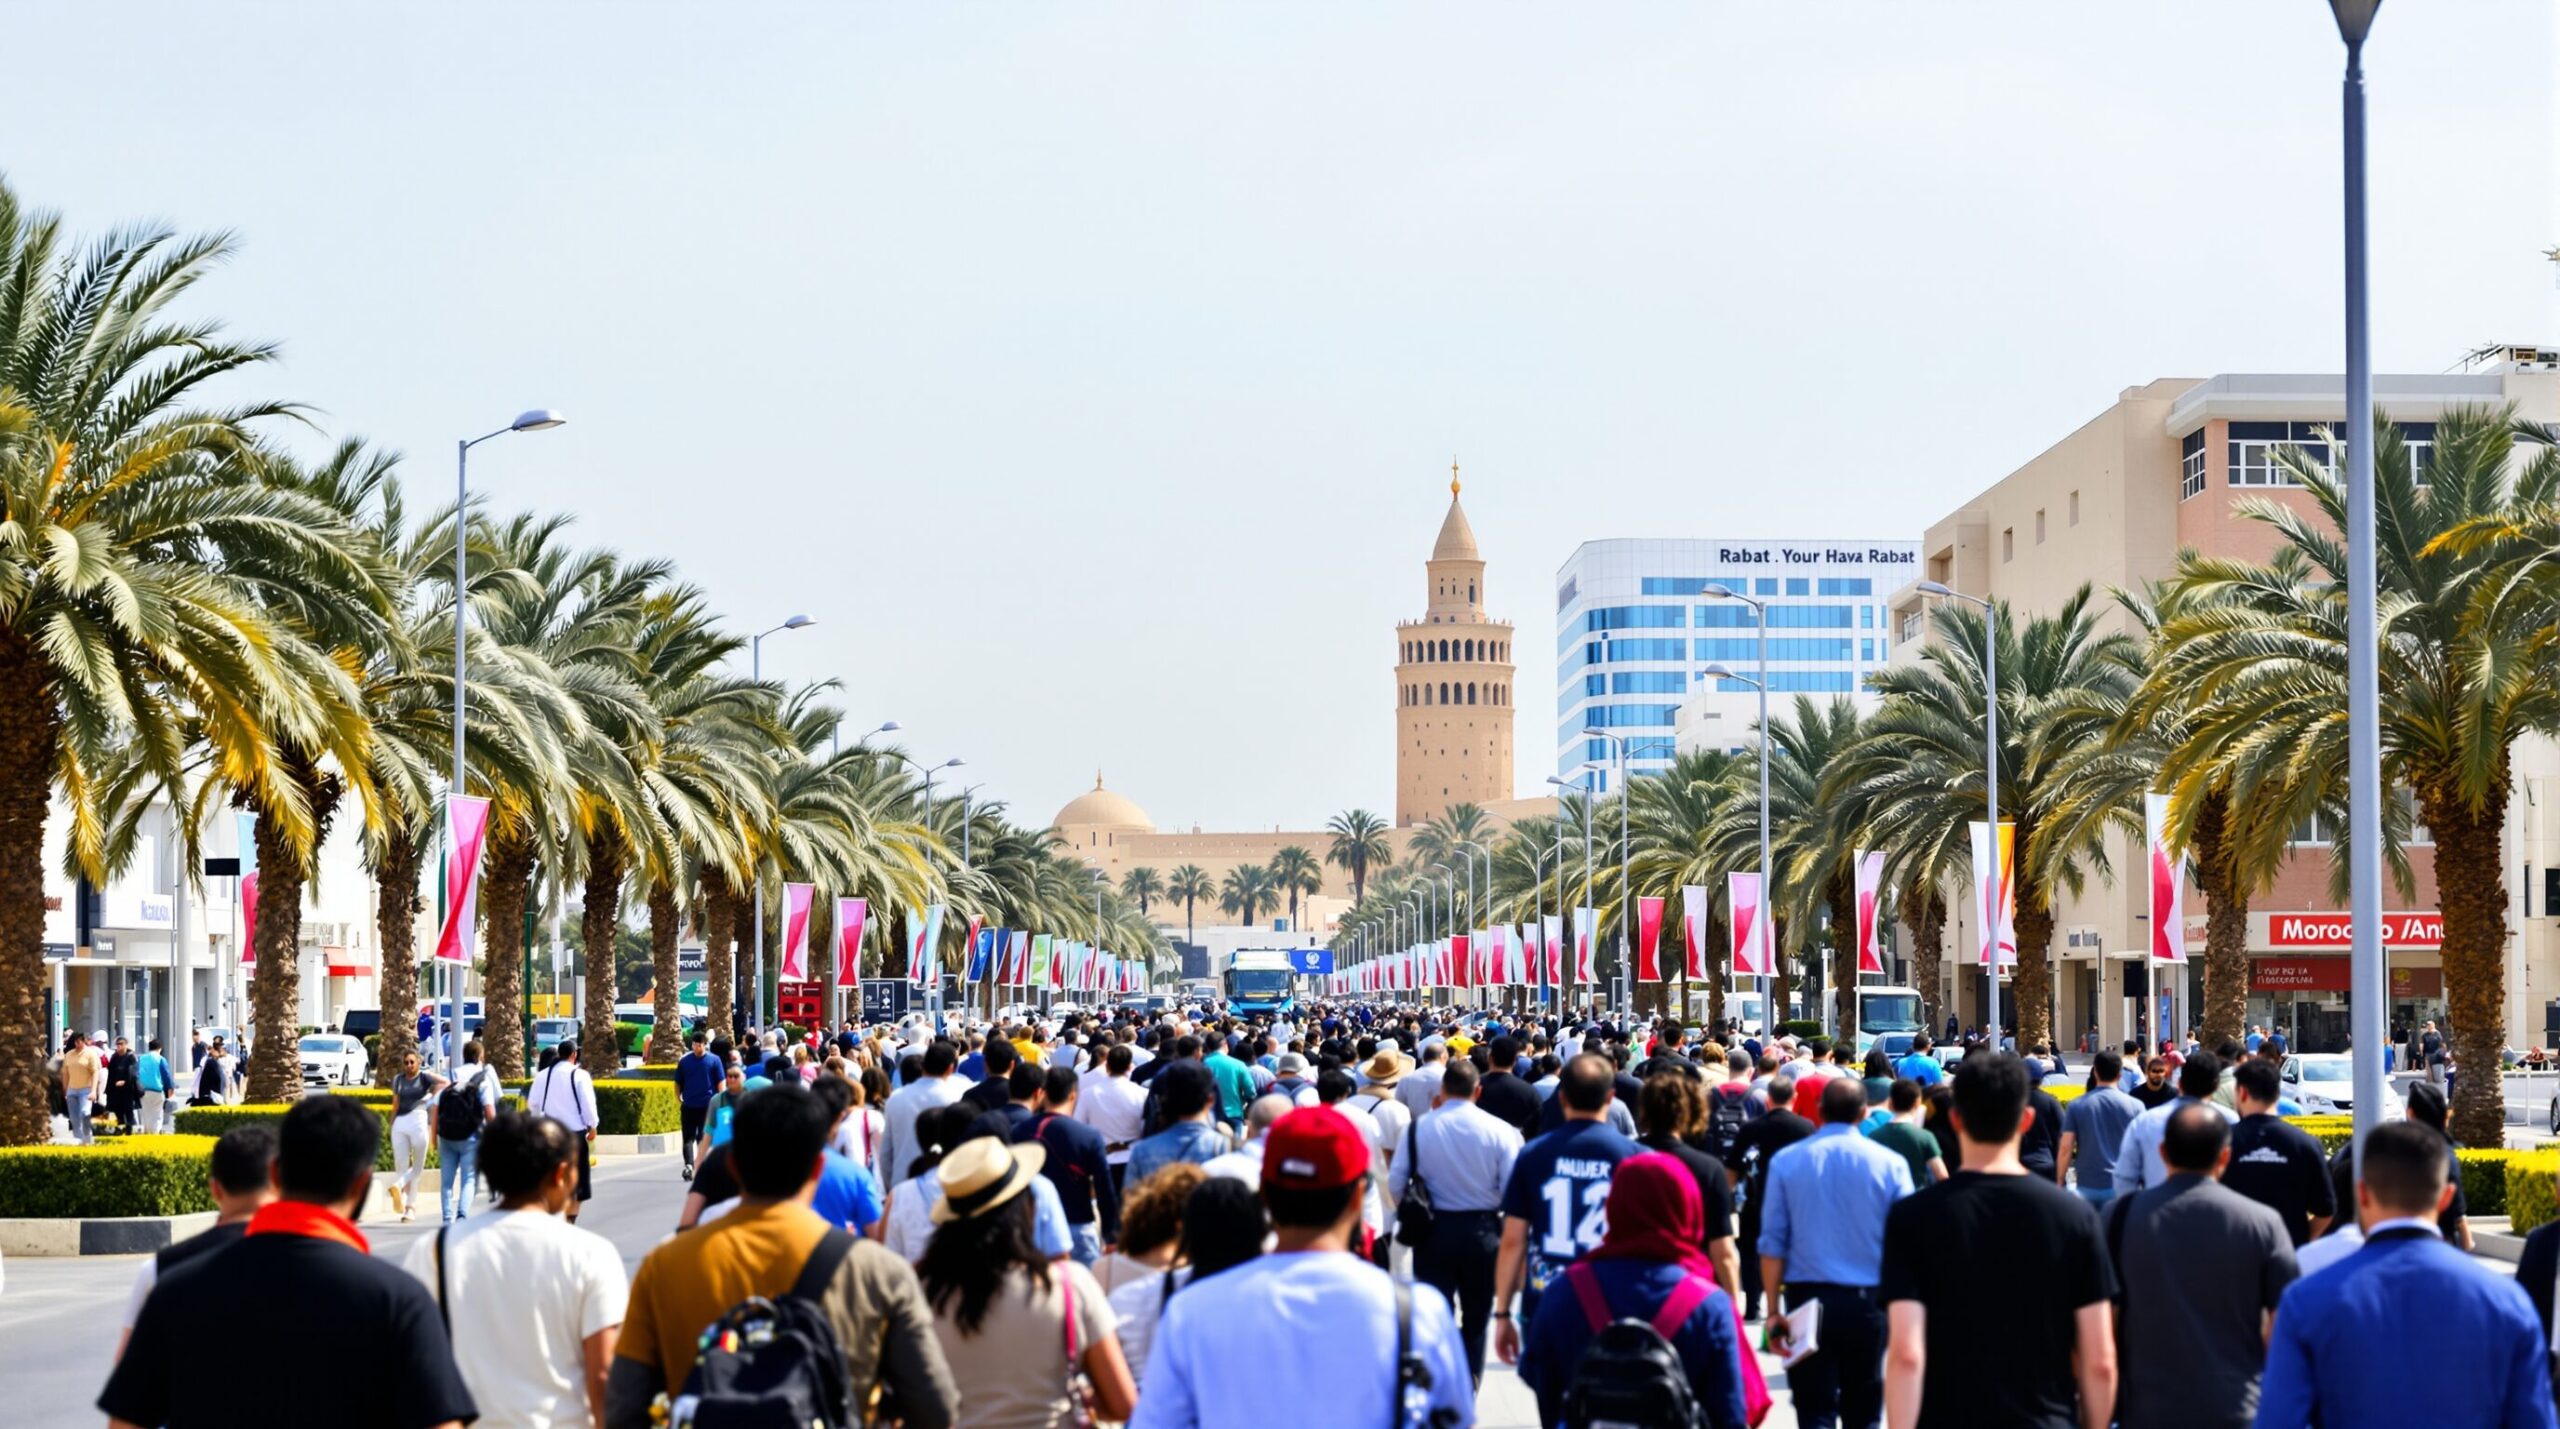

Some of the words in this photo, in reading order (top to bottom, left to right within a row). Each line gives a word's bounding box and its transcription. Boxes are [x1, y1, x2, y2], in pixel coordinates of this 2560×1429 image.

[1720, 548, 1770, 563] Rabat
[1782, 549, 1820, 563] Your
[1826, 549, 1863, 563] Hava
[1869, 549, 1914, 563] Rabat
[2282, 918, 2394, 940] Moroco
